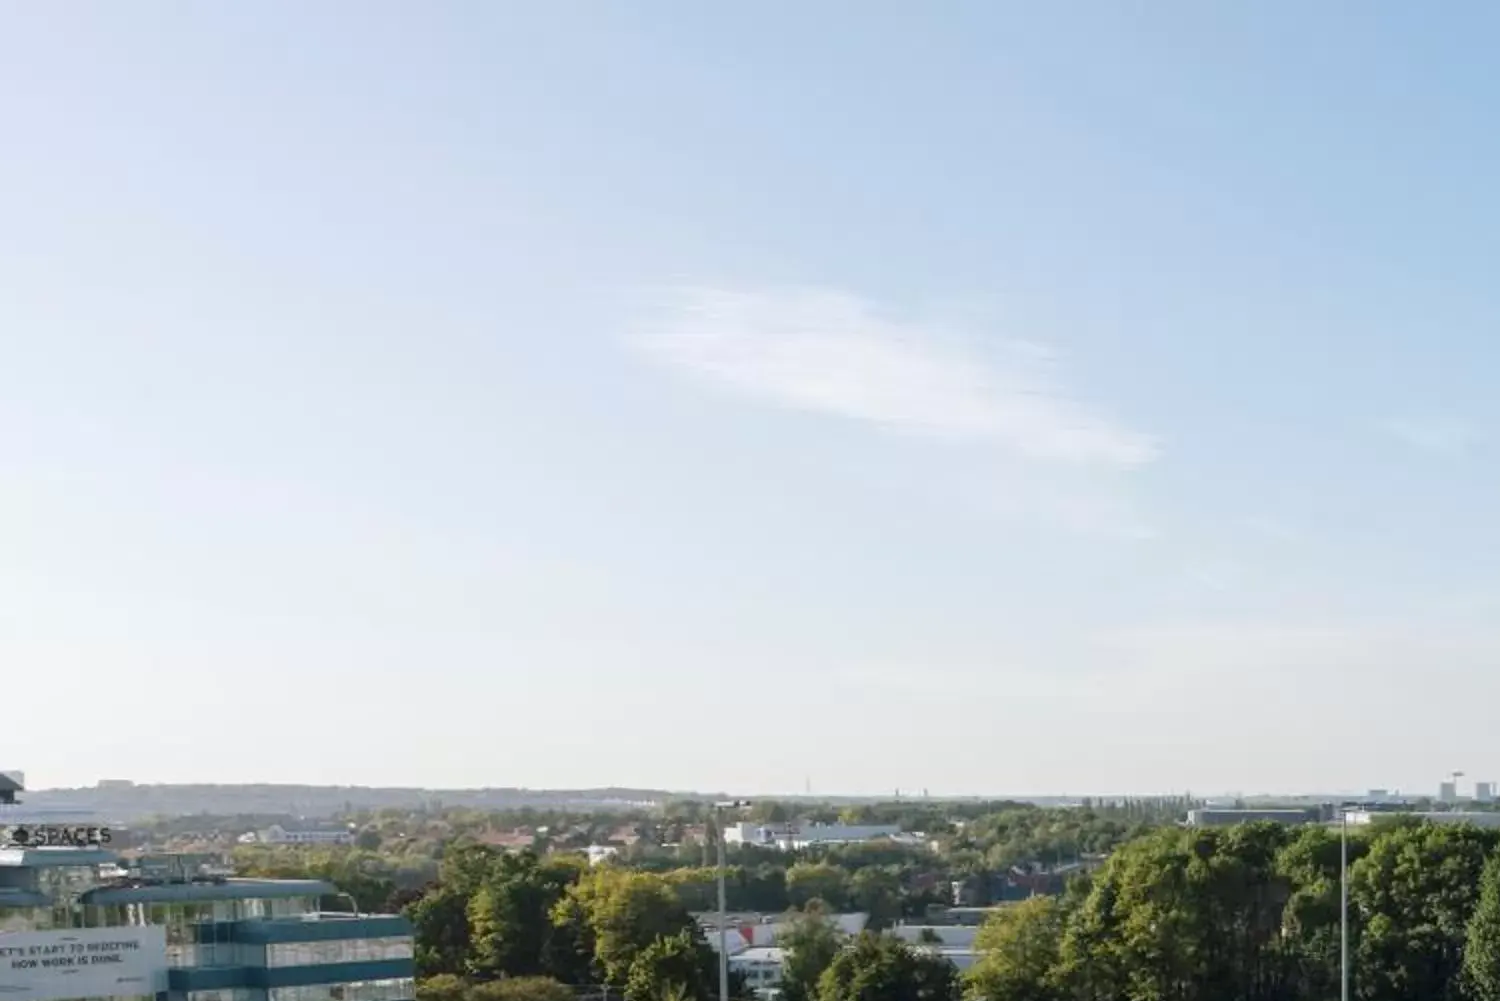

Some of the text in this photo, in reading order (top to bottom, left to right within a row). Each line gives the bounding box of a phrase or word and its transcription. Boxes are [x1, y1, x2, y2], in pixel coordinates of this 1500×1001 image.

[35, 827, 112, 845] SPACES
[29, 943, 65, 956] START
[70, 942, 85, 954] TO
[11, 959, 38, 970] HOW
[41, 956, 75, 968] WORK
[77, 955, 89, 965] IS
